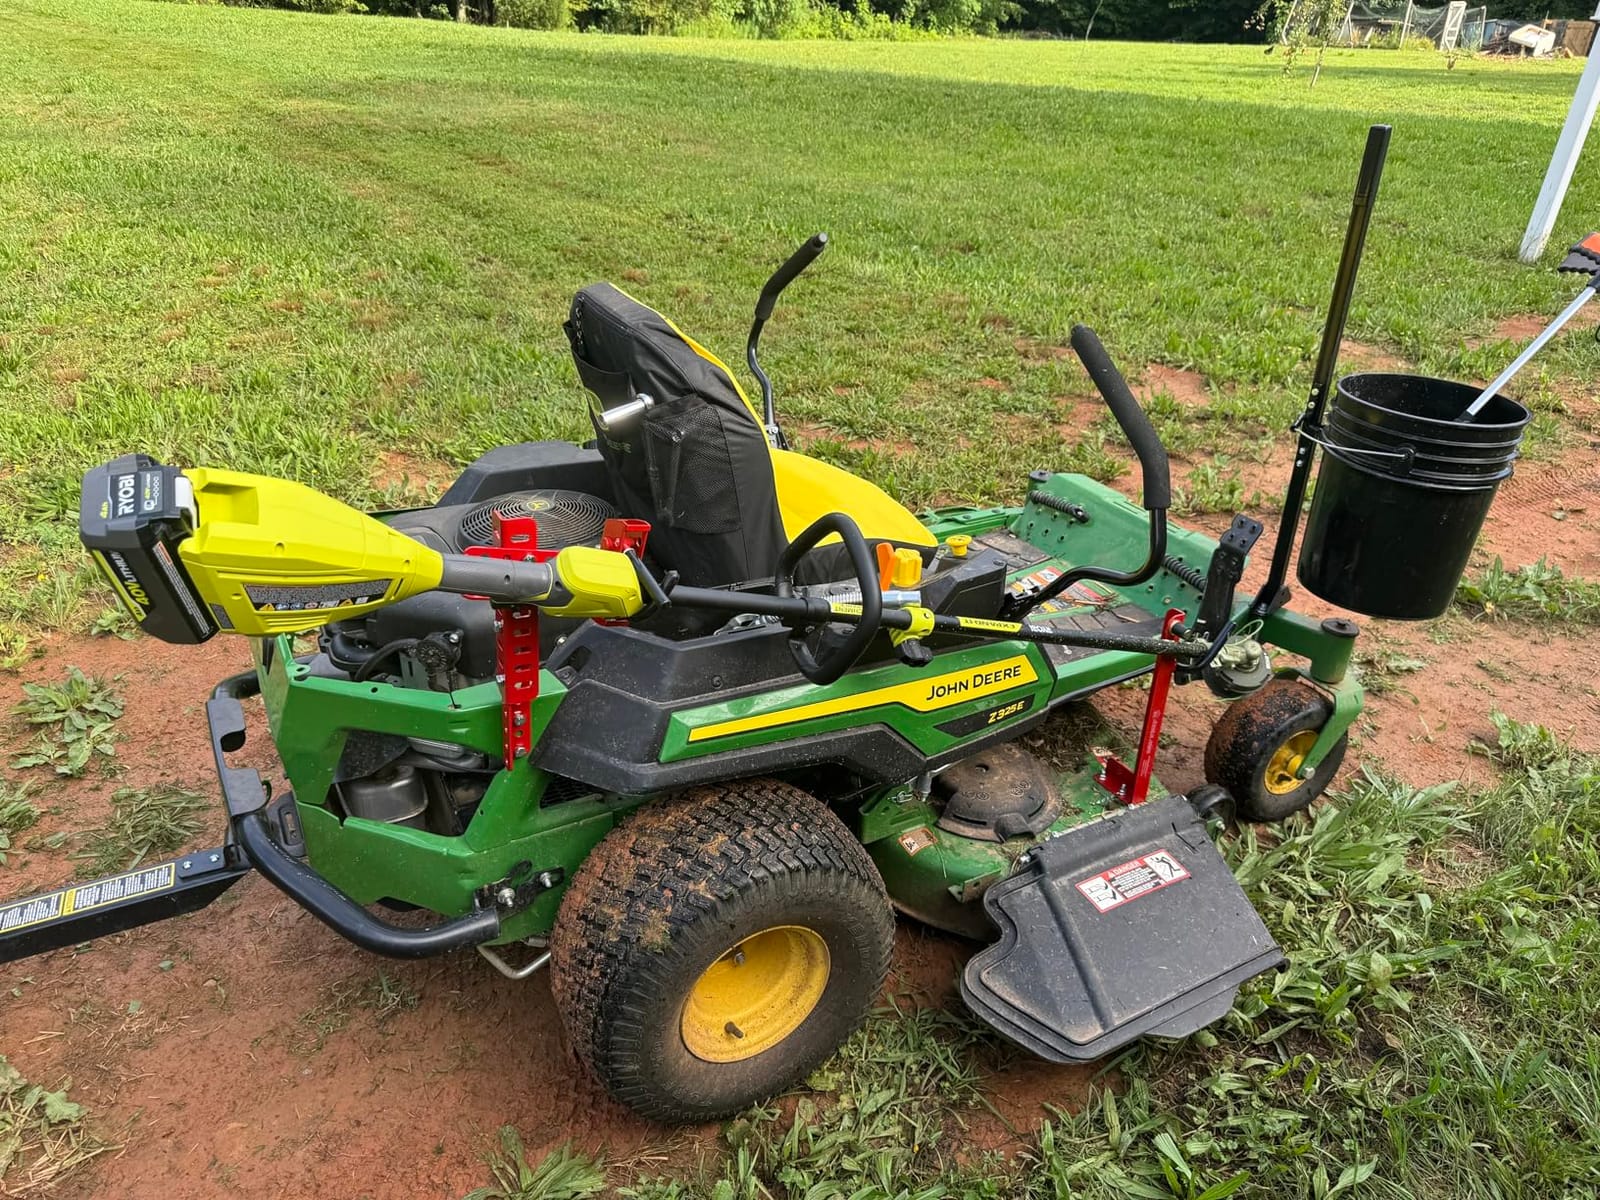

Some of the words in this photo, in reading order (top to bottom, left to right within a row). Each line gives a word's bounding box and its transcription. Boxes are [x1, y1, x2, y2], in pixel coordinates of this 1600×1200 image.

[118, 474, 135, 517] RYOBI
[124, 581, 150, 605] 40V
[926, 679, 969, 701] JOHN
[973, 665, 1021, 688] DEERE
